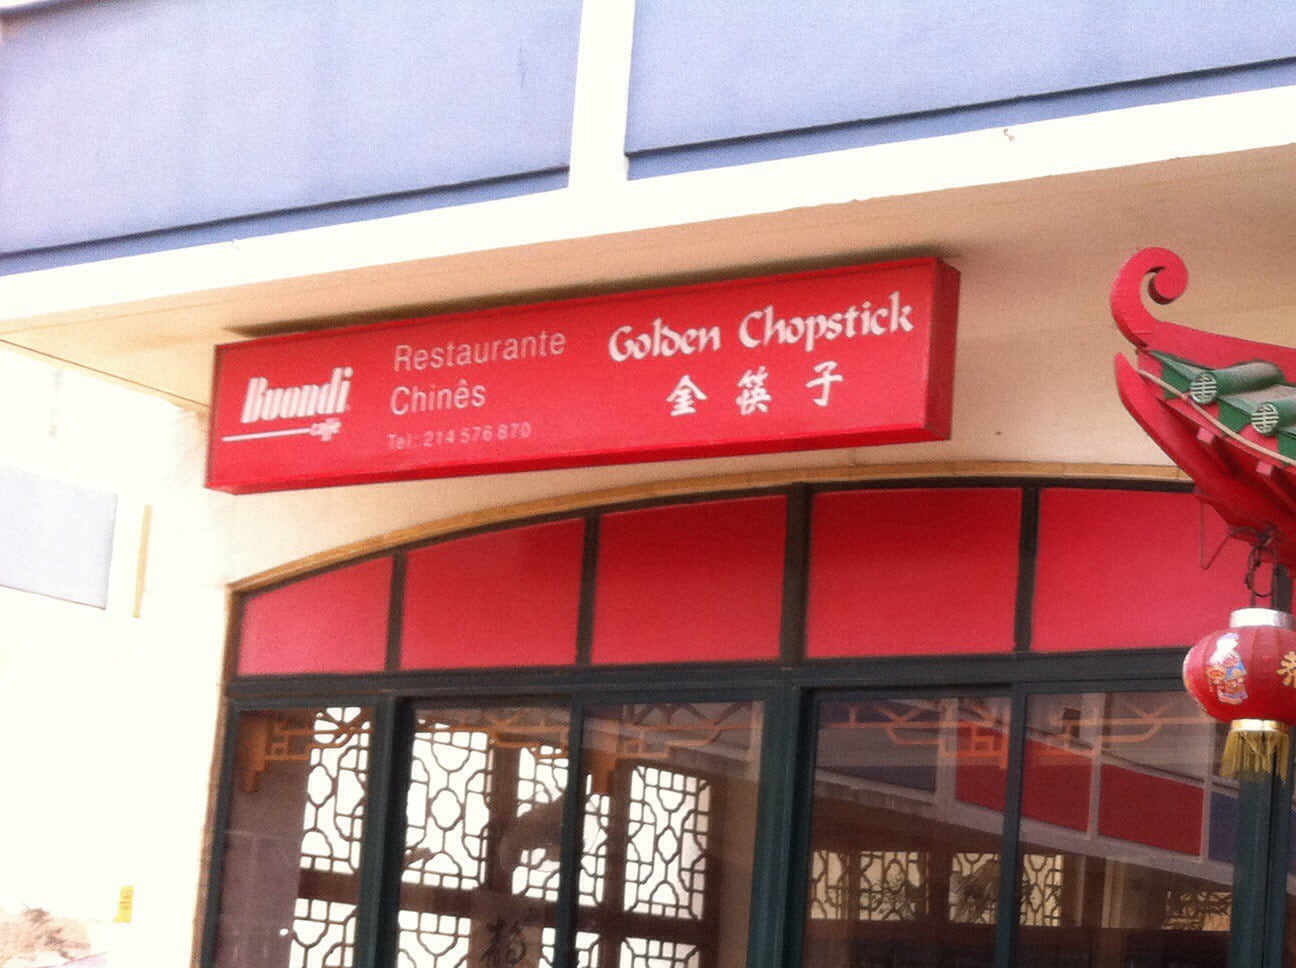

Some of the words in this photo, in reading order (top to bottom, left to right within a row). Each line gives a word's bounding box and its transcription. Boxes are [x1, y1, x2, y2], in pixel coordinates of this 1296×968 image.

[608, 317, 722, 362] Golden
[738, 290, 915, 352] Chopstick
[394, 331, 567, 372] Restaurante
[390, 379, 487, 416] Chinês
[422, 429, 456, 447] 214
